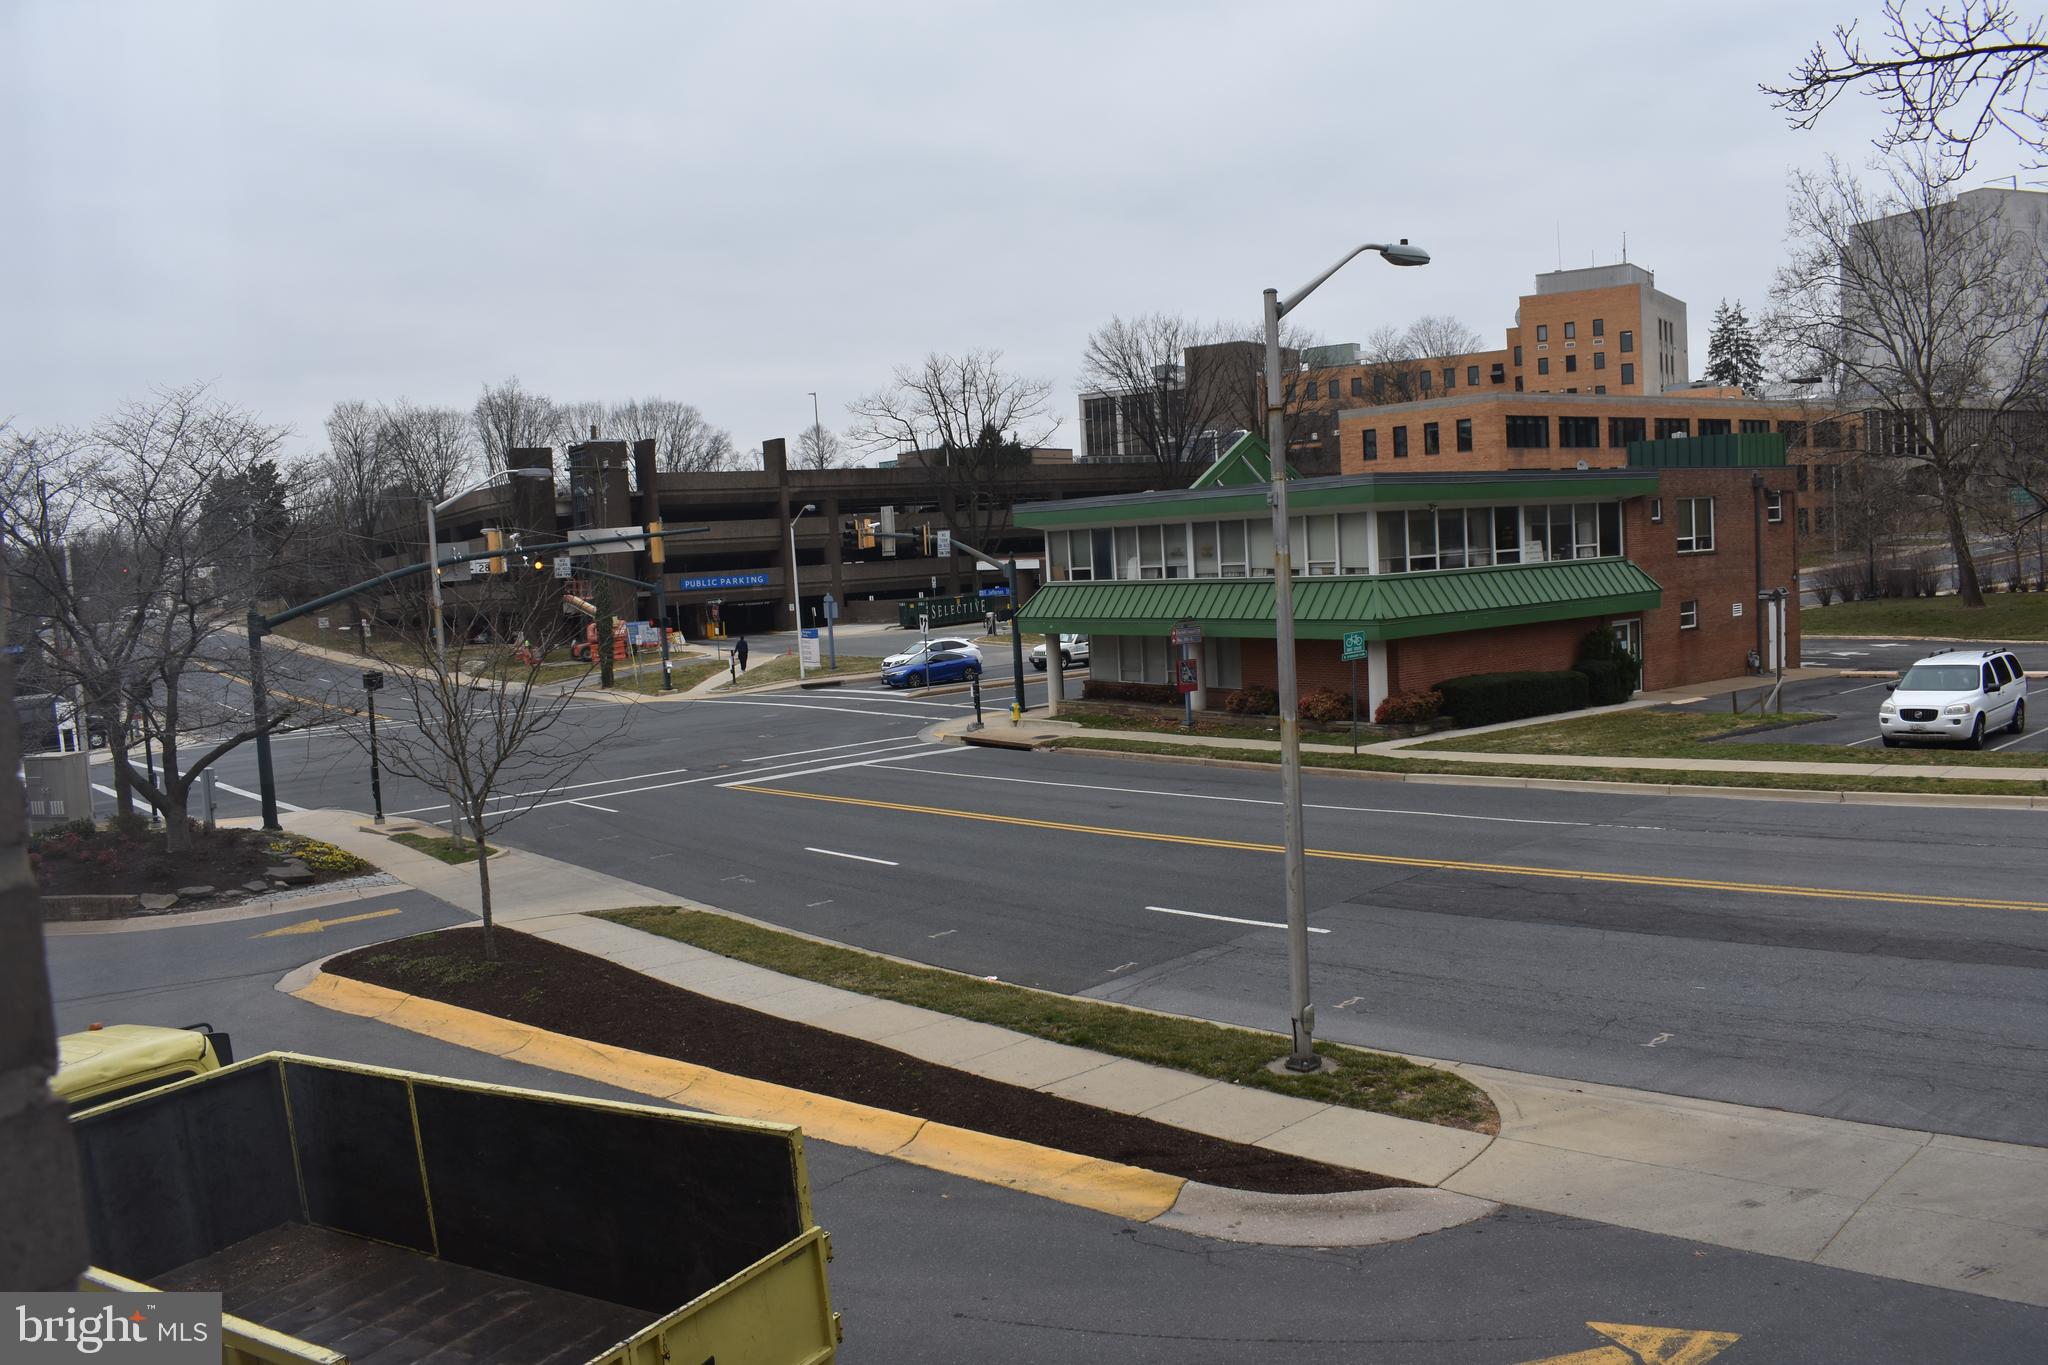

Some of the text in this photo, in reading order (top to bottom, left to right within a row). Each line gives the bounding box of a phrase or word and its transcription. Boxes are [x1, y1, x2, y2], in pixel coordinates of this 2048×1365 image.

[684, 575, 764, 588] PUBLIC PARKING
[931, 599, 986, 619] SELECTIVE
